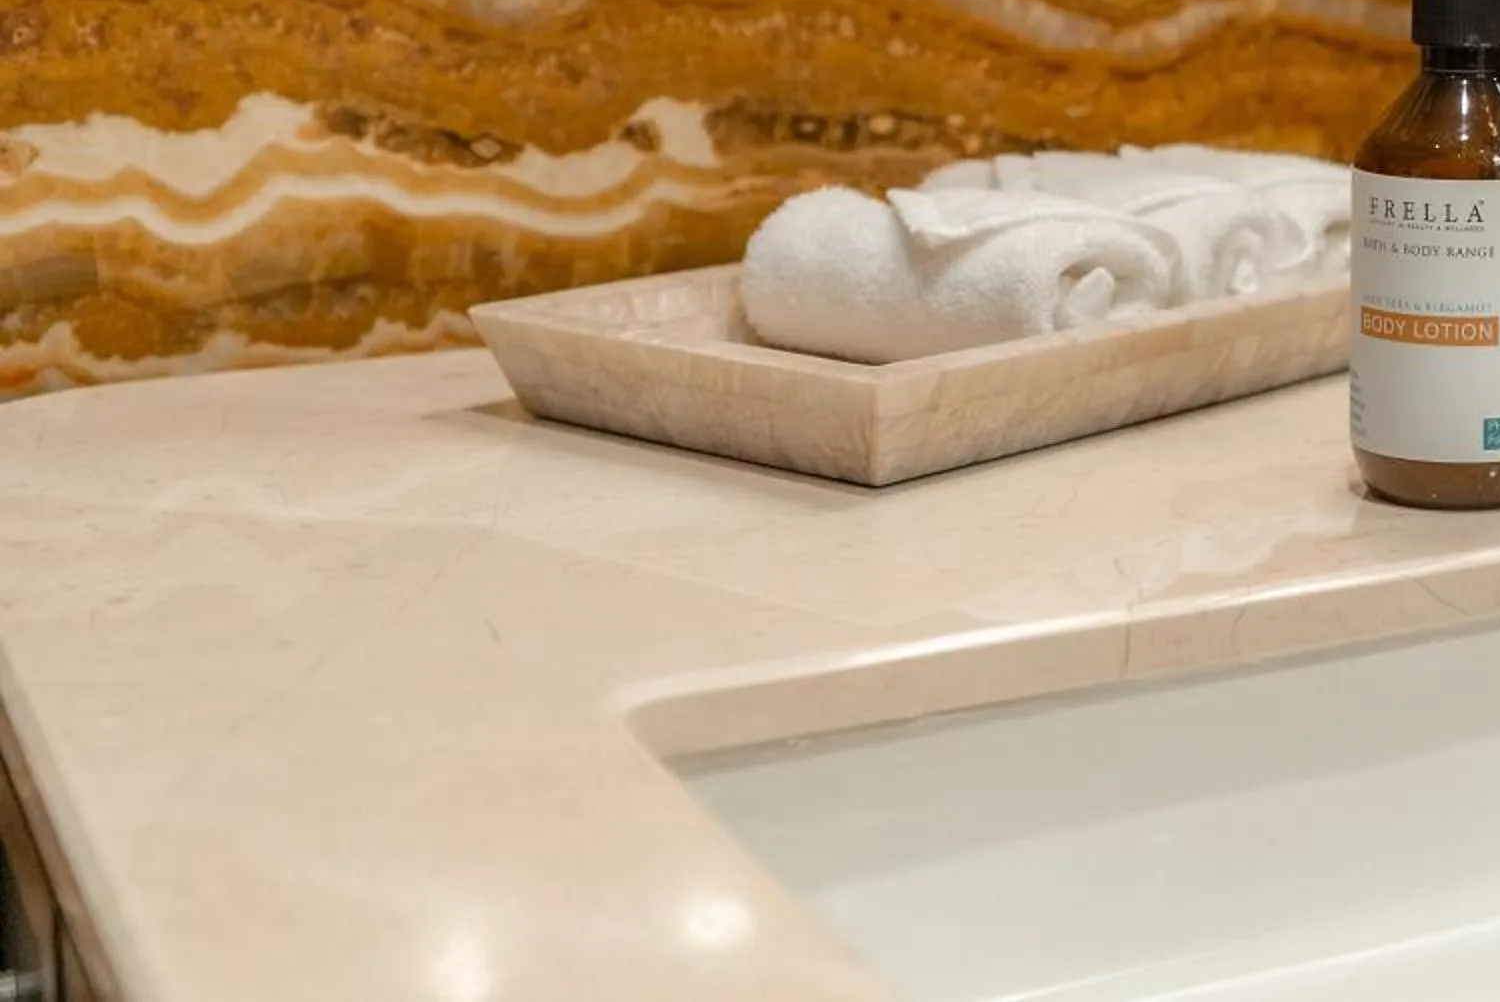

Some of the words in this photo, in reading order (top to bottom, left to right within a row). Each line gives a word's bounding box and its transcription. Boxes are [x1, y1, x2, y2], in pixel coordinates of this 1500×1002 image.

[1370, 197, 1483, 223] FRELLA
[1403, 243, 1439, 257] BODY
[1363, 313, 1407, 336] BODY
[1413, 321, 1494, 341] LOTION
